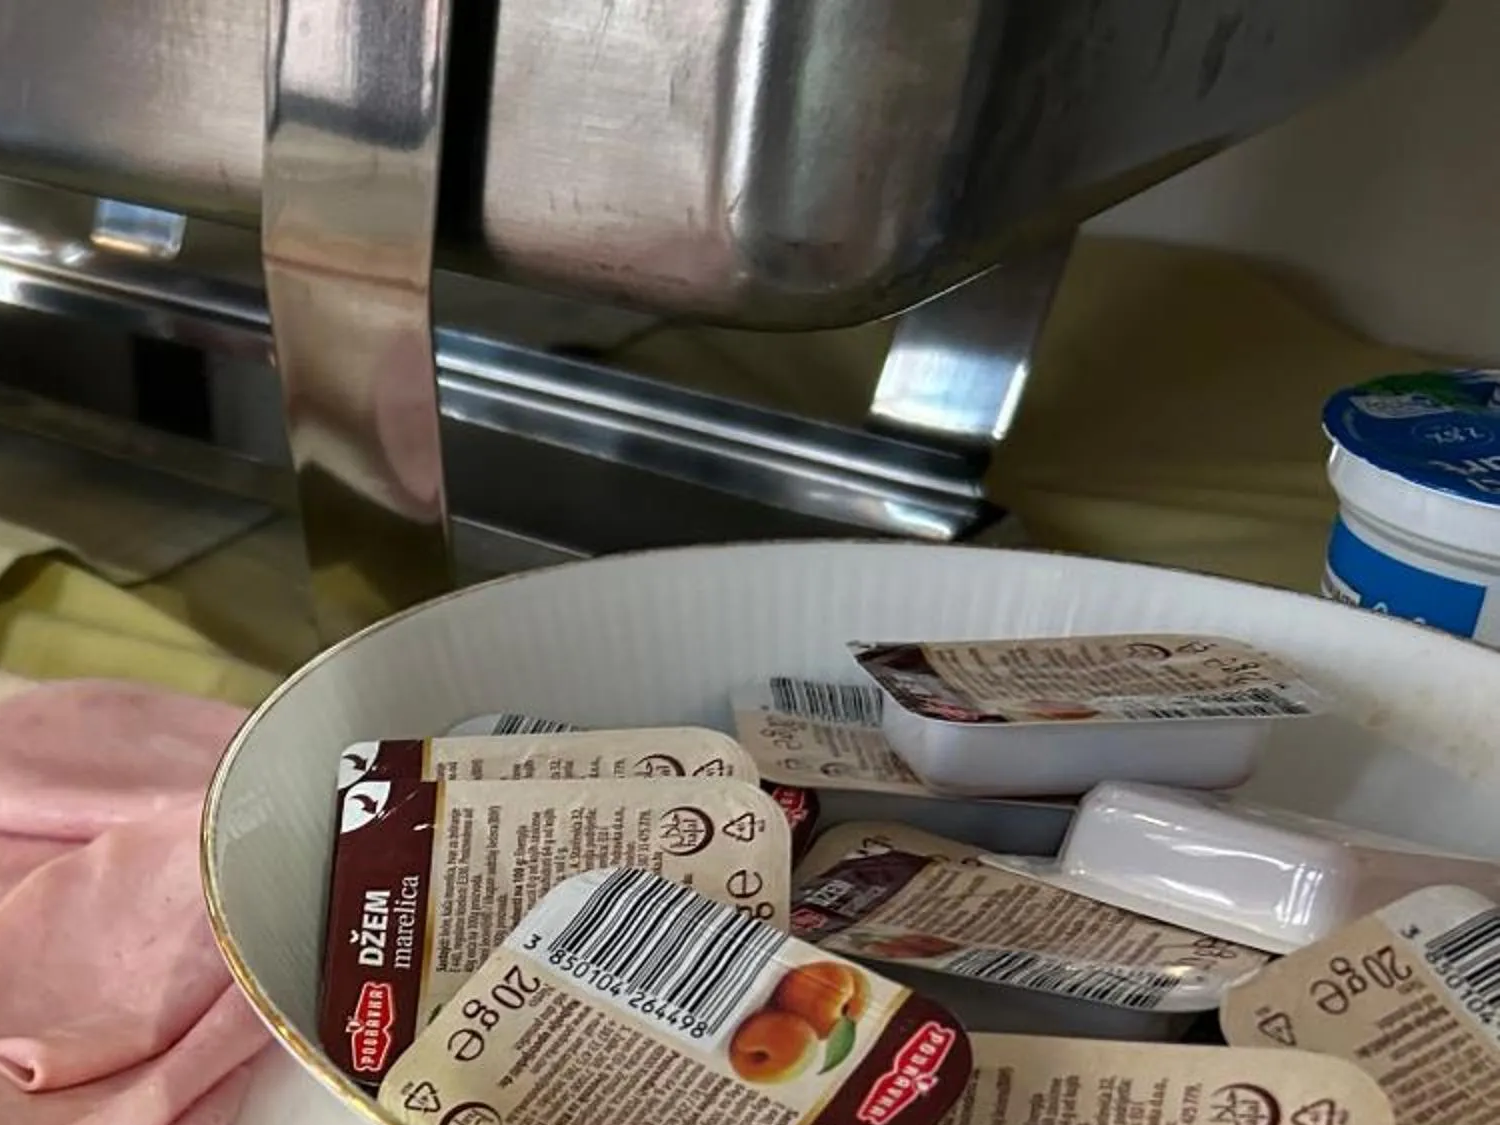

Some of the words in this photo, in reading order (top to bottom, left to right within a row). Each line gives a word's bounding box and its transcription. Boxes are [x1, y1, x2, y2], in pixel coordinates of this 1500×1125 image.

[350, 890, 391, 967] DŽEM
[393, 875, 420, 969] marelica
[490, 965, 541, 1010] 20
[524, 934, 542, 950] 3
[549, 950, 624, 997] 850104
[628, 991, 708, 1039] 264498
[1361, 945, 1412, 989] 20
[867, 1029, 946, 1119] PODRAVKA
